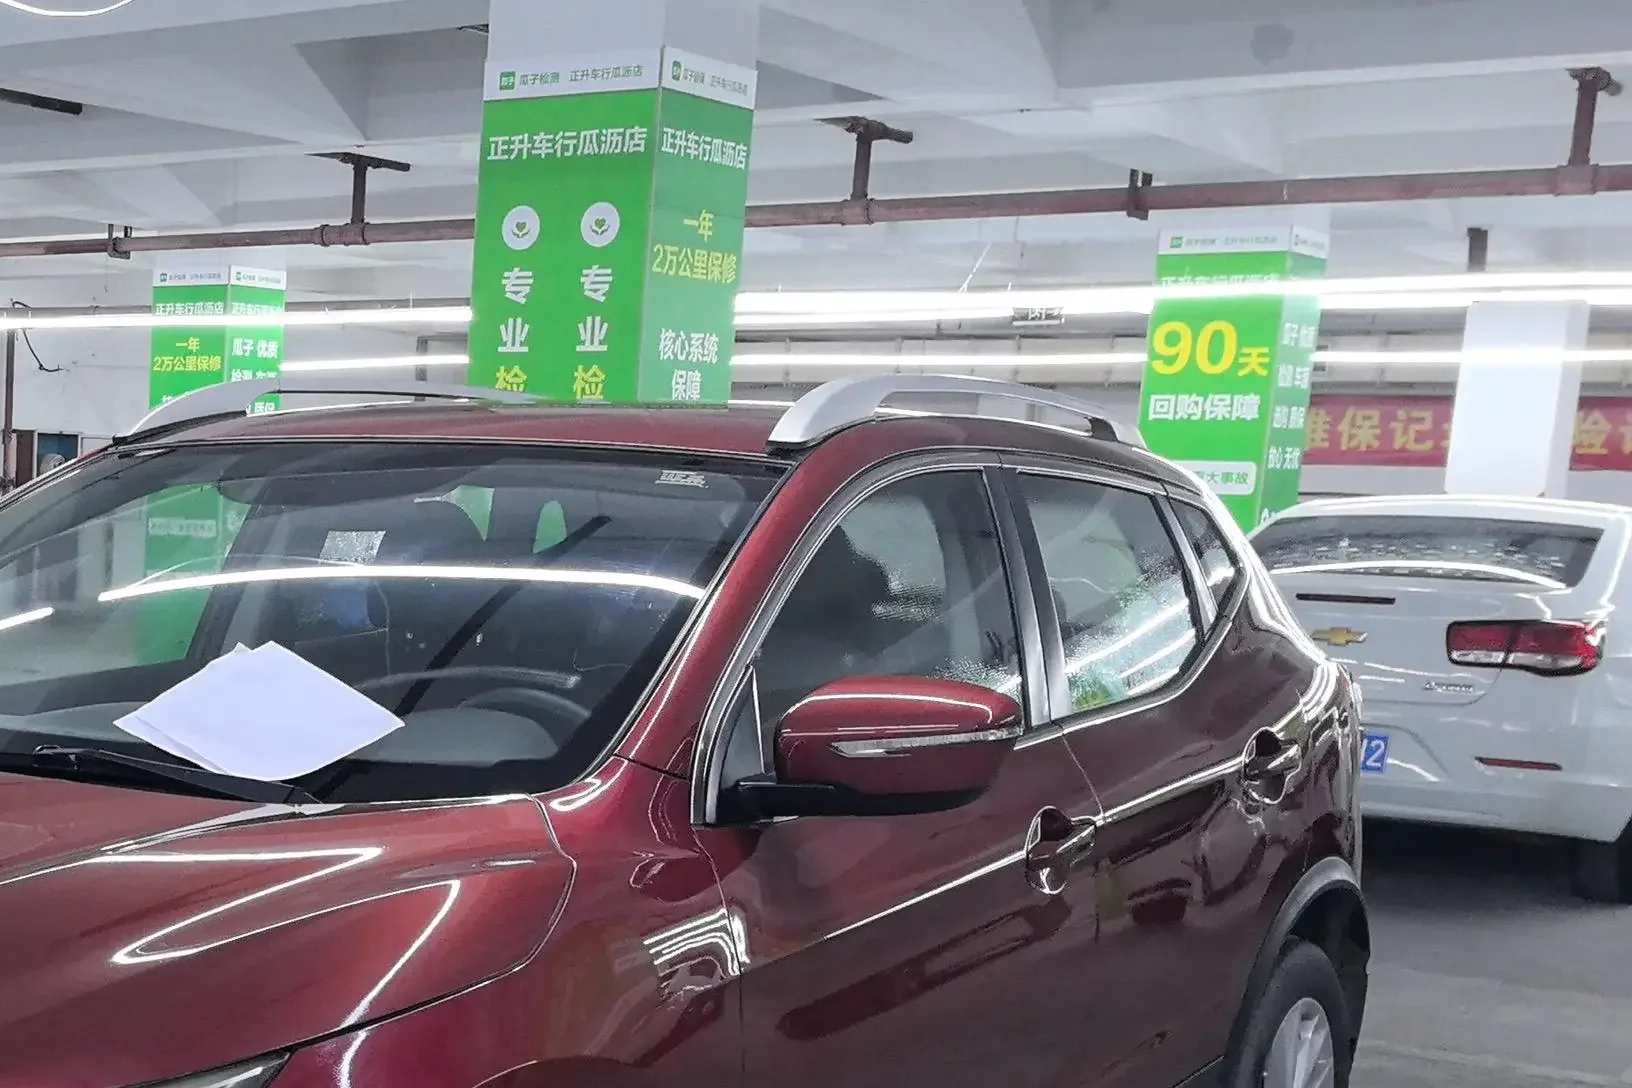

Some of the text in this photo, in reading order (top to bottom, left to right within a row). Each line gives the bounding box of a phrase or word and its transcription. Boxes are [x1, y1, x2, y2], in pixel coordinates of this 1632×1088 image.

[487, 126, 647, 161] 正升车行瓜沥店
[661, 127, 747, 170] 正升车行瓜沥店
[683, 209, 714, 242] 一年
[652, 243, 737, 284] 2万公里保修
[175, 336, 200, 353] 一年
[658, 328, 719, 363] 核心系统
[1150, 320, 1270, 377] 90天
[153, 354, 223, 372] 2万公里保修
[672, 369, 702, 401] 保障
[1148, 393, 1261, 421] 回购保障
[1308, 407, 1451, 452] 保记
